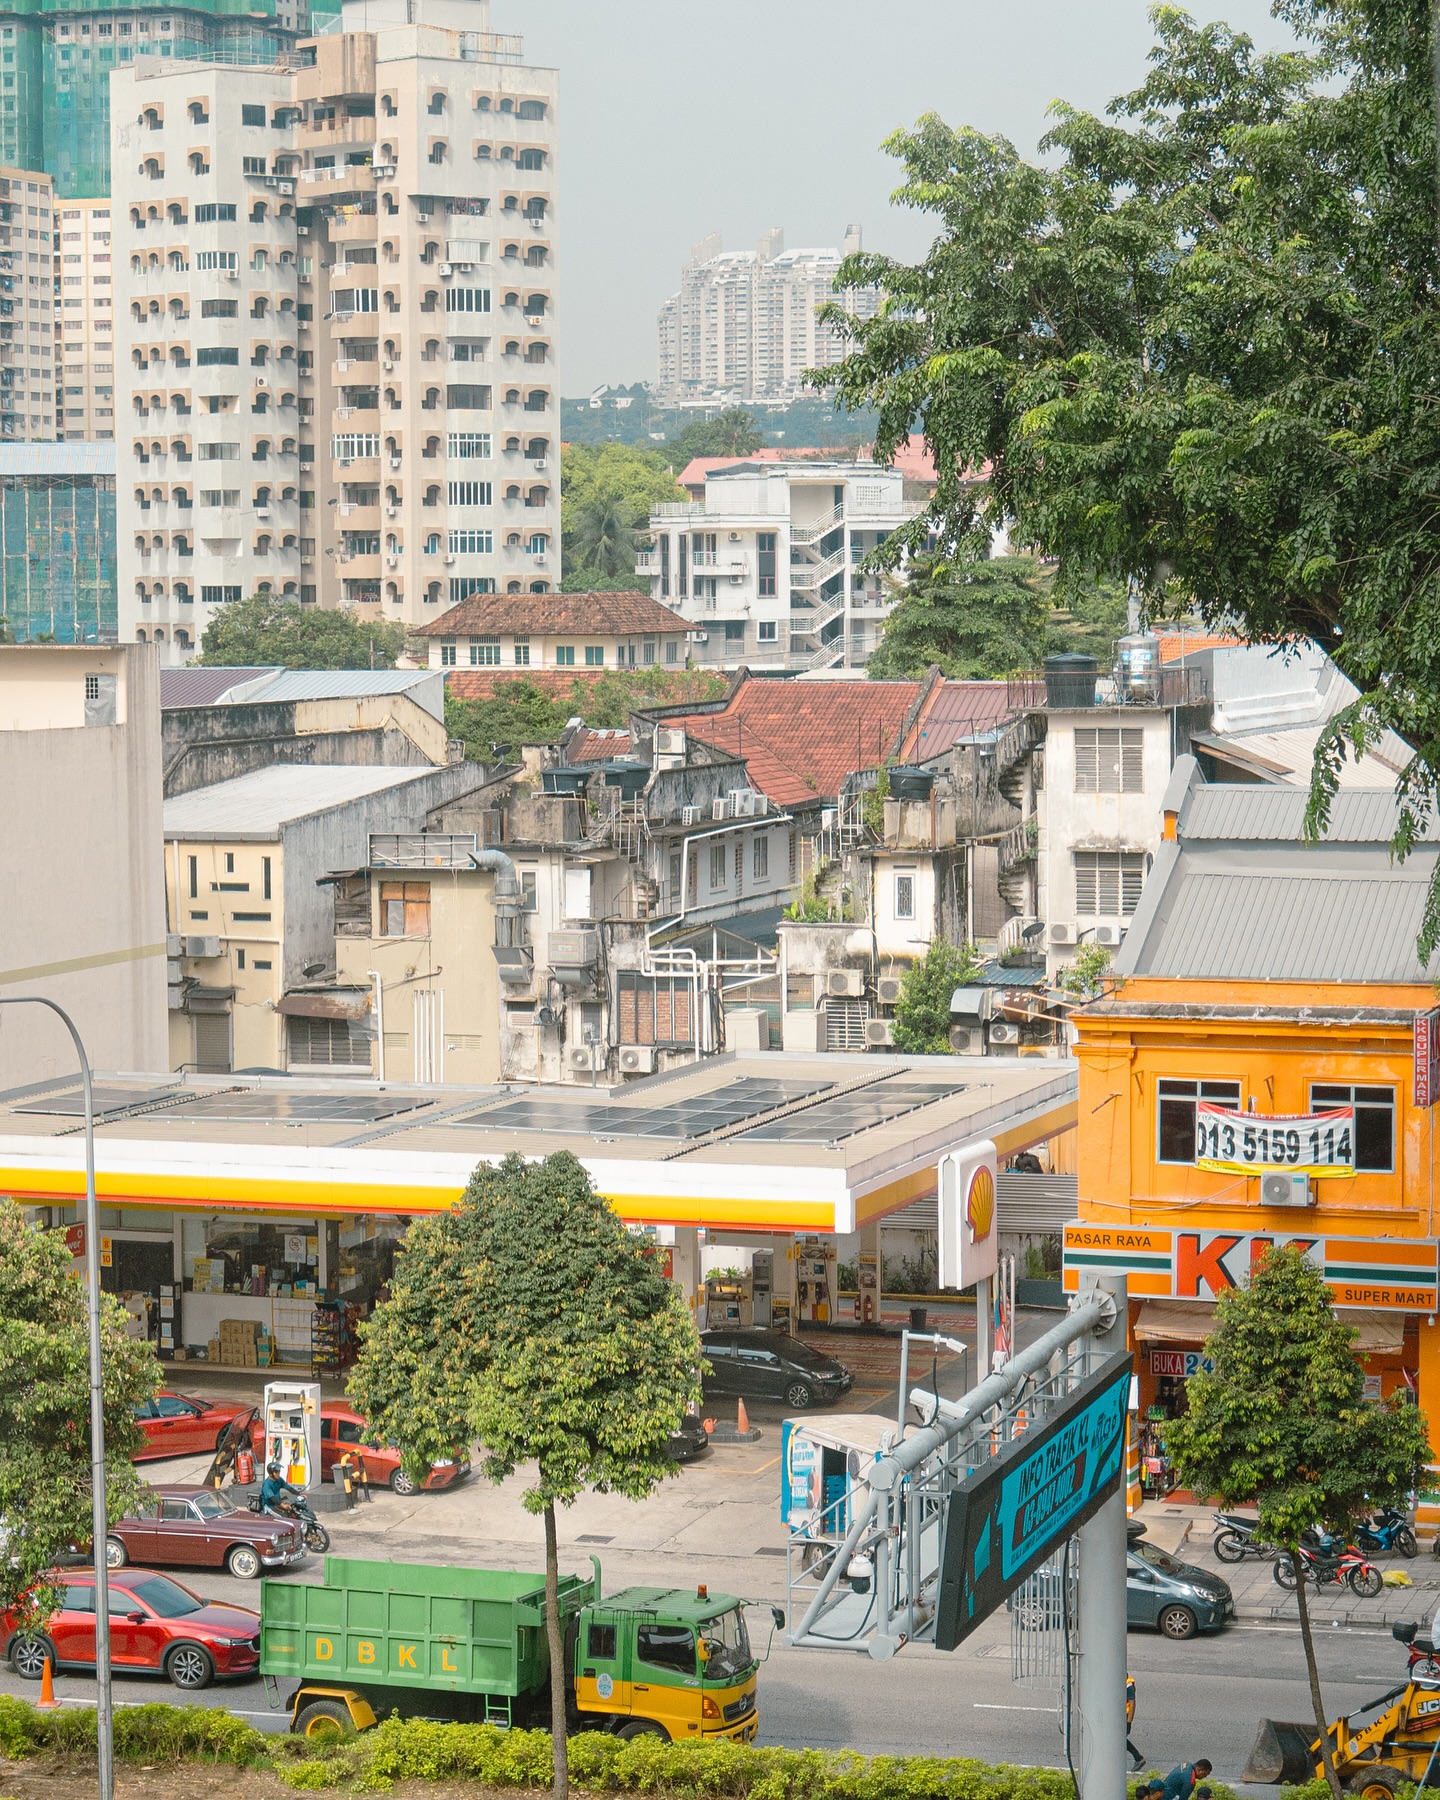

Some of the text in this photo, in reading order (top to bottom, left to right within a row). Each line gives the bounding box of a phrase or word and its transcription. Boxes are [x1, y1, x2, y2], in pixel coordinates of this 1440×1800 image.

[1243, 1128, 1300, 1163] 5159
[1309, 1128, 1352, 1164] 114
[104, 1240, 109, 1248] 8
[1066, 1232, 1151, 1247] PASAR RAYA
[102, 1254, 111, 1263] 10
[1345, 1289, 1433, 1305] SUPER MART
[1153, 1353, 1183, 1374] BUKA
[1018, 1454, 1043, 1504] INFO
[1045, 1422, 1079, 1480] TRAFIK
[1077, 1413, 1089, 1451] KL
[1418, 1699, 1440, 1714] JC
[1356, 1714, 1391, 1742] DBKL
